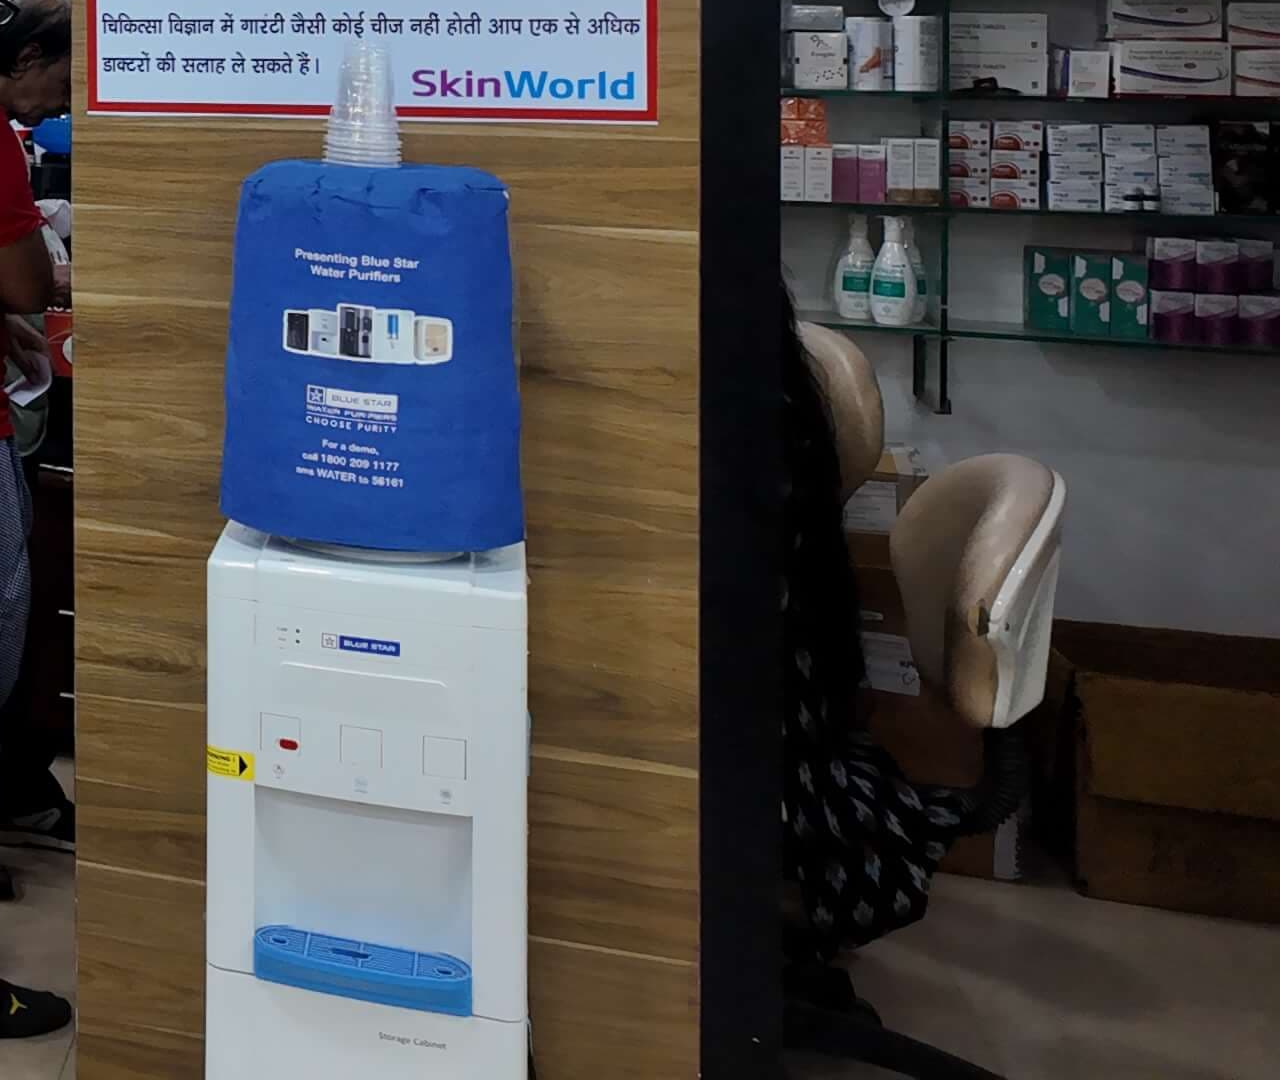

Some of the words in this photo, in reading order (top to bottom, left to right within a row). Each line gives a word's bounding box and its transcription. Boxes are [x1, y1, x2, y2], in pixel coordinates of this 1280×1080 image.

[102, 12, 163, 35] चिकित्सा
[168, 12, 215, 36] विज्ञान
[220, 12, 235, 35] में
[240, 12, 285, 36] गारंटी
[291, 12, 327, 35] जैसी
[332, 11, 365, 38] कोई
[370, 12, 404, 35] चीज
[445, 11, 482, 36] होती
[489, 18, 523, 35] आप
[528, 18, 559, 37] एक
[564, 12, 582, 35] से
[587, 11, 641, 35] अधिक
[102, 51, 151, 73] डाक्टरों
[156, 51, 176, 73] की
[181, 58, 225, 75] सलाह
[231, 51, 247, 73] ले
[251, 51, 293, 73] सकते
[411, 69, 635, 100] SkinWorld
[295, 248, 358, 267] Presenting
[361, 255, 390, 268] Blue
[393, 257, 420, 269] Star
[310, 264, 346, 278] Water
[349, 269, 401, 283] Purifiers
[331, 395, 360, 404] BLUE
[363, 398, 392, 408] STAR
[305, 416, 352, 430] CHOOSE
[357, 423, 397, 433] PURITY
[322, 439, 338, 449] For
[340, 443, 347, 451] a
[321, 454, 347, 466] 1800
[372, 461, 400, 472] 1177
[316, 468, 356, 483] WATER
[358, 475, 369, 484] to
[343, 639, 368, 649] BLUE
[371, 642, 396, 653] STAR
